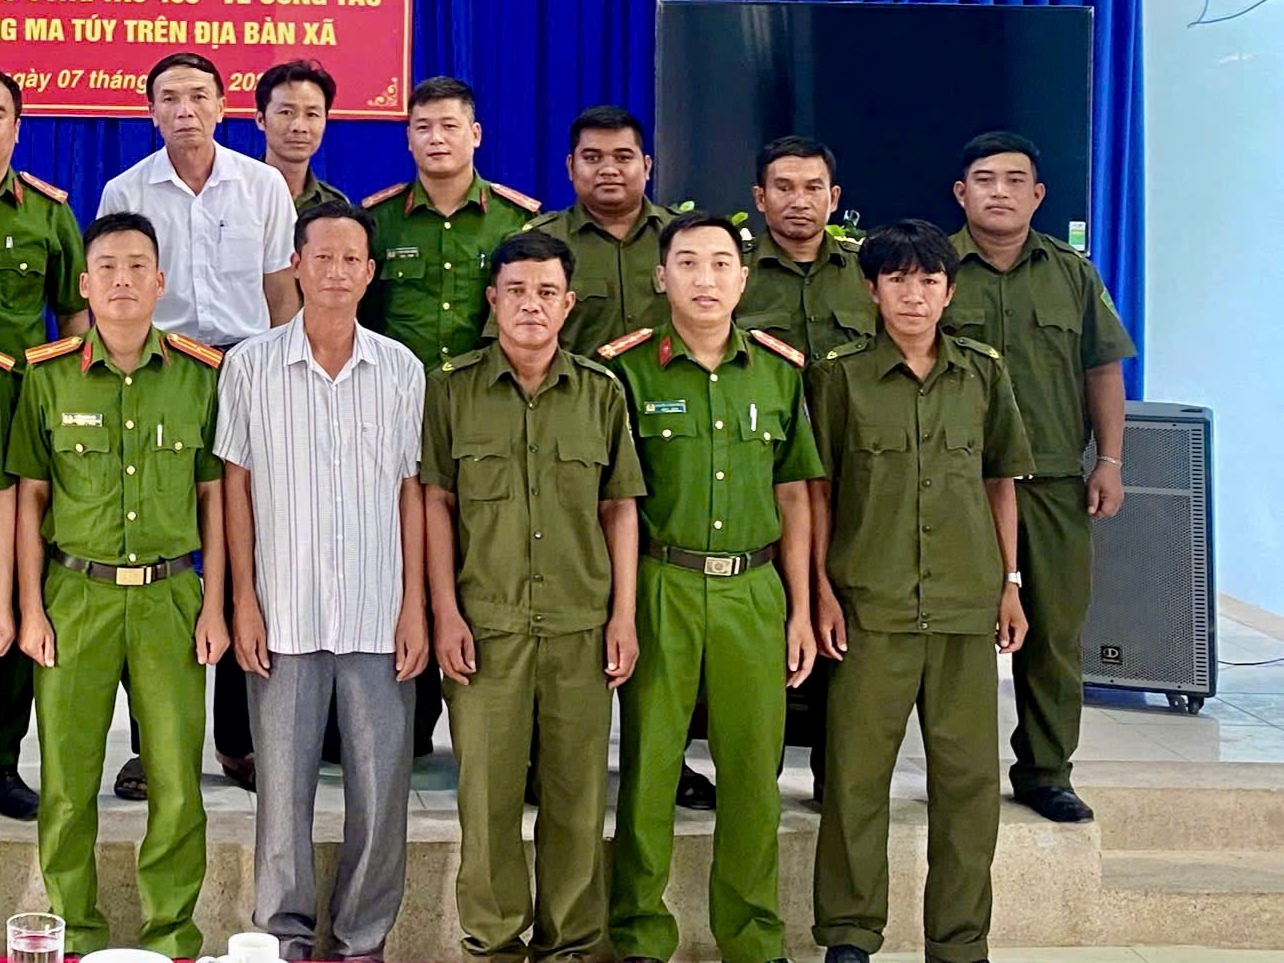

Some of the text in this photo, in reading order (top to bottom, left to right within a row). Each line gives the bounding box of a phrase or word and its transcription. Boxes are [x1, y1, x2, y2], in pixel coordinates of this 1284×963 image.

[24, 18, 65, 42] MA
[71, 13, 117, 42] TÚY
[123, 16, 188, 44] TRÊN
[193, 20, 237, 50] ĐỊA
[243, 17, 296, 46] BÀN
[302, 18, 337, 46] XÃ
[6, 68, 53, 93] gày
[57, 69, 85, 89] 07
